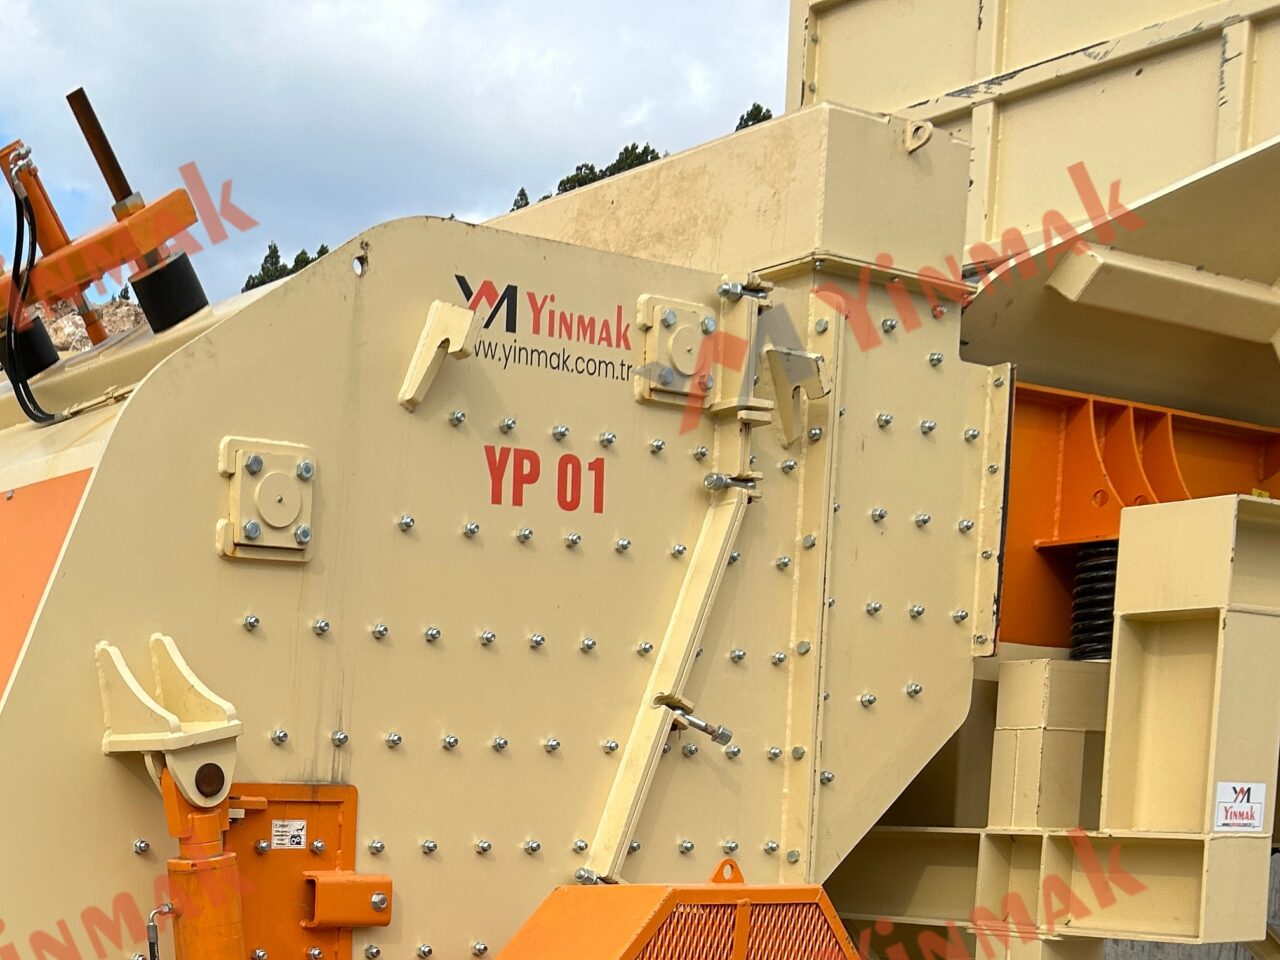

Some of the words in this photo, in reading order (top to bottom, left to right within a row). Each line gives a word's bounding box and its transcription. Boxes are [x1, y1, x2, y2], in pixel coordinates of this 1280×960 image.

[473, 338, 634, 382] w.yinmak.com.tr
[484, 445, 540, 507] YP
[557, 453, 605, 514] 01
